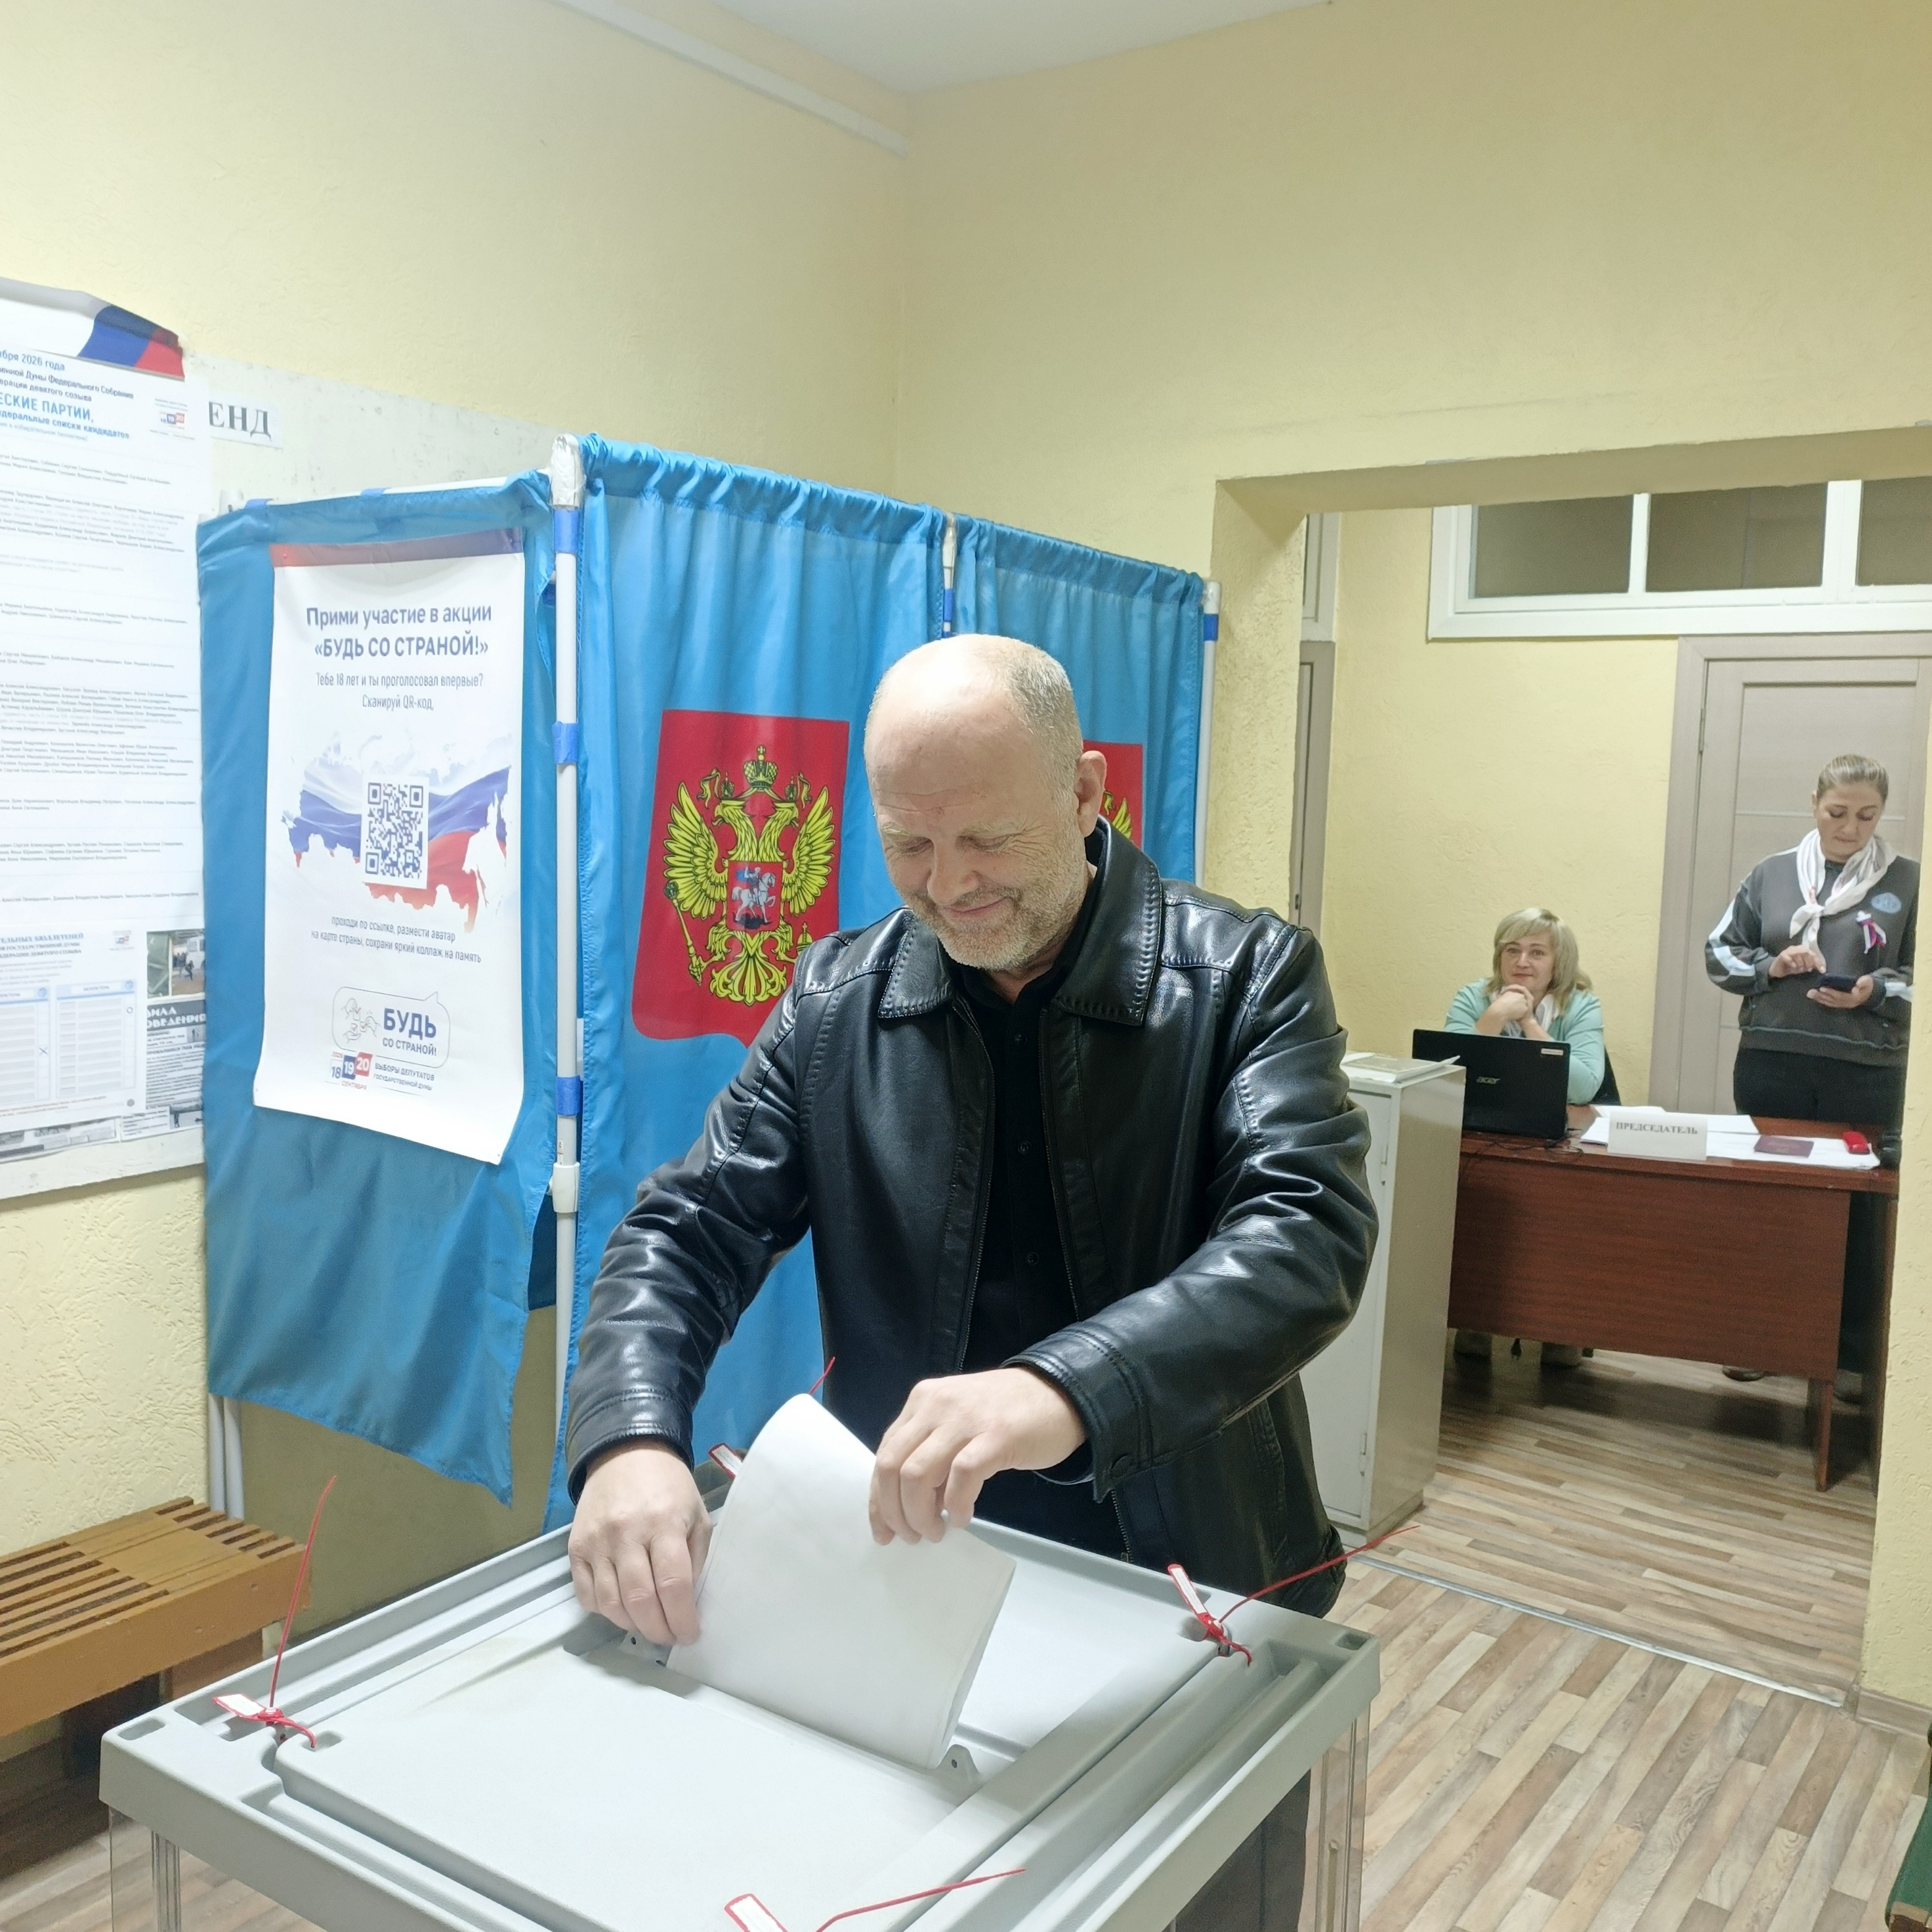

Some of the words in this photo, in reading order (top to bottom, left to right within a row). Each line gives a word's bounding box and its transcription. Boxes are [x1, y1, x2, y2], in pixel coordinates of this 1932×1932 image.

[0, 350, 18, 362] бря
[22, 354, 43, 366] 2026
[45, 360, 65, 371] года
[0, 368, 24, 377] енной
[0, 410, 50, 425] деральные
[52, 419, 81, 430] списки
[42, 400, 94, 423] ПАРТИИ,
[208, 400, 272, 442] ЕНД
[306, 608, 358, 631] Прими
[362, 608, 426, 631] участие
[430, 608, 439, 623] в
[442, 605, 492, 625] акции
[314, 638, 364, 660] «БУДЬ
[368, 637, 390, 657] СО
[394, 629, 488, 657] СТРАНОЙ!»
[316, 672, 334, 686] Тебе
[336, 673, 345, 686] 18
[346, 675, 359, 686] лет
[362, 676, 367, 686] и
[368, 675, 379, 686] ты
[381, 675, 438, 690] проголосовал
[440, 673, 484, 690] впервые?
[362, 694, 400, 712] Сканируй
[403, 694, 434, 711] QR-код,
[331, 916, 358, 928] проходи
[360, 919, 368, 930] по
[397, 925, 430, 937] размести
[431, 930, 456, 944] аватар
[311, 931, 319, 939] на
[320, 932, 338, 942] карте
[366, 938, 393, 950] сохрани
[394, 942, 415, 954] яркий
[417, 945, 443, 957] коллаж
[445, 950, 453, 959] на
[455, 951, 482, 963] память
[384, 1007, 436, 1040] БУДЬ
[383, 1038, 394, 1048] СО
[396, 1040, 436, 1056] СТРАНОЙ!
[331, 1066, 341, 1080] 18
[344, 1060, 355, 1076] 19
[356, 1057, 369, 1072] 20
[375, 1062, 400, 1074] ВЫБОРЫ
[400, 1068, 434, 1081] ДЕПУТАТОВ
[1616, 1122, 1698, 1135] ПРЕДСЕДАТЕЛЬ
